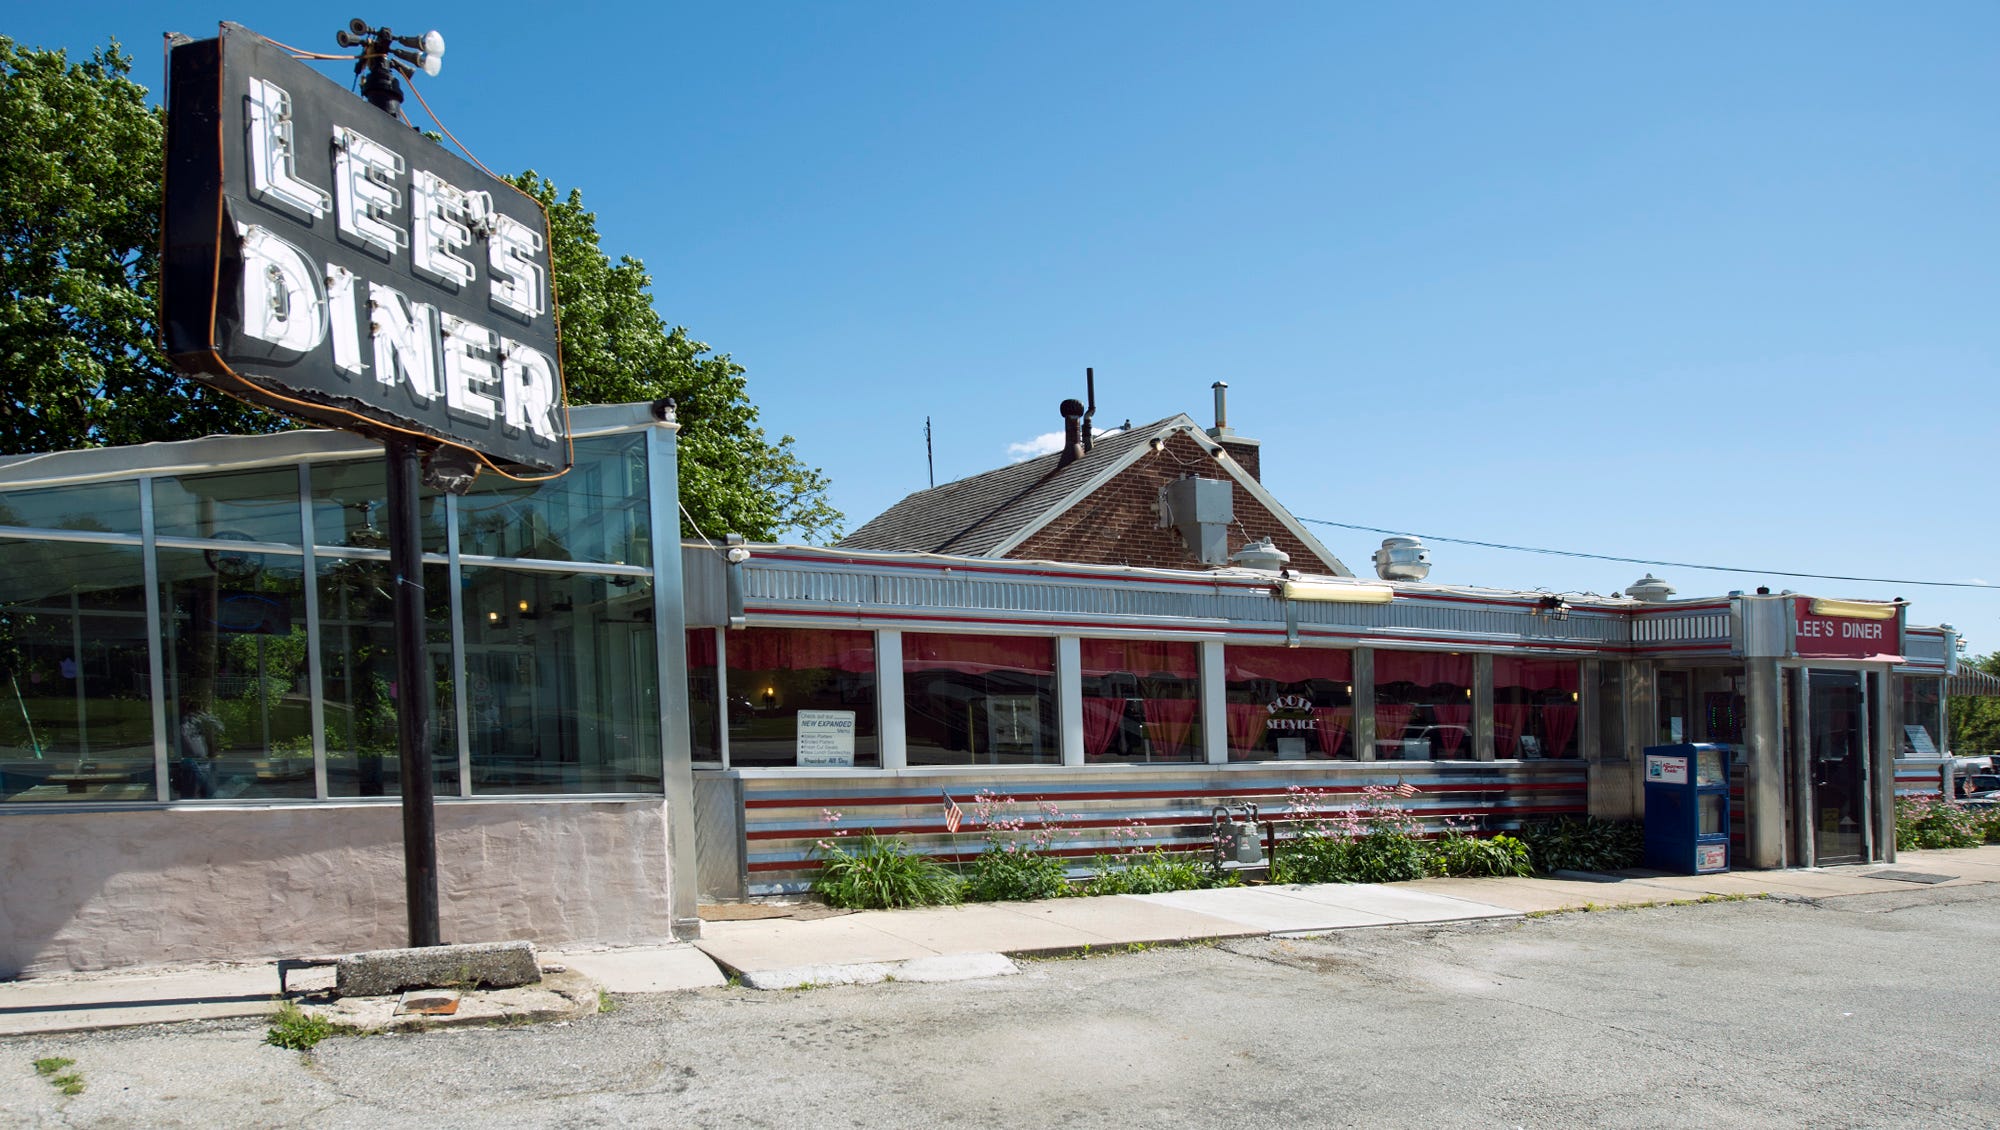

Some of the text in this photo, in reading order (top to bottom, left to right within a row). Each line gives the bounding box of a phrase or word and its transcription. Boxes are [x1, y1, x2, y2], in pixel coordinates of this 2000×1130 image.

[248, 76, 546, 319] LEE'S
[237, 220, 560, 442] DINER
[1795, 619, 1882, 639] LEE'S DINER
[1266, 695, 1315, 714] BOOTH
[817, 720, 852, 728] EXPANDED
[1266, 719, 1317, 730] SERVICE
